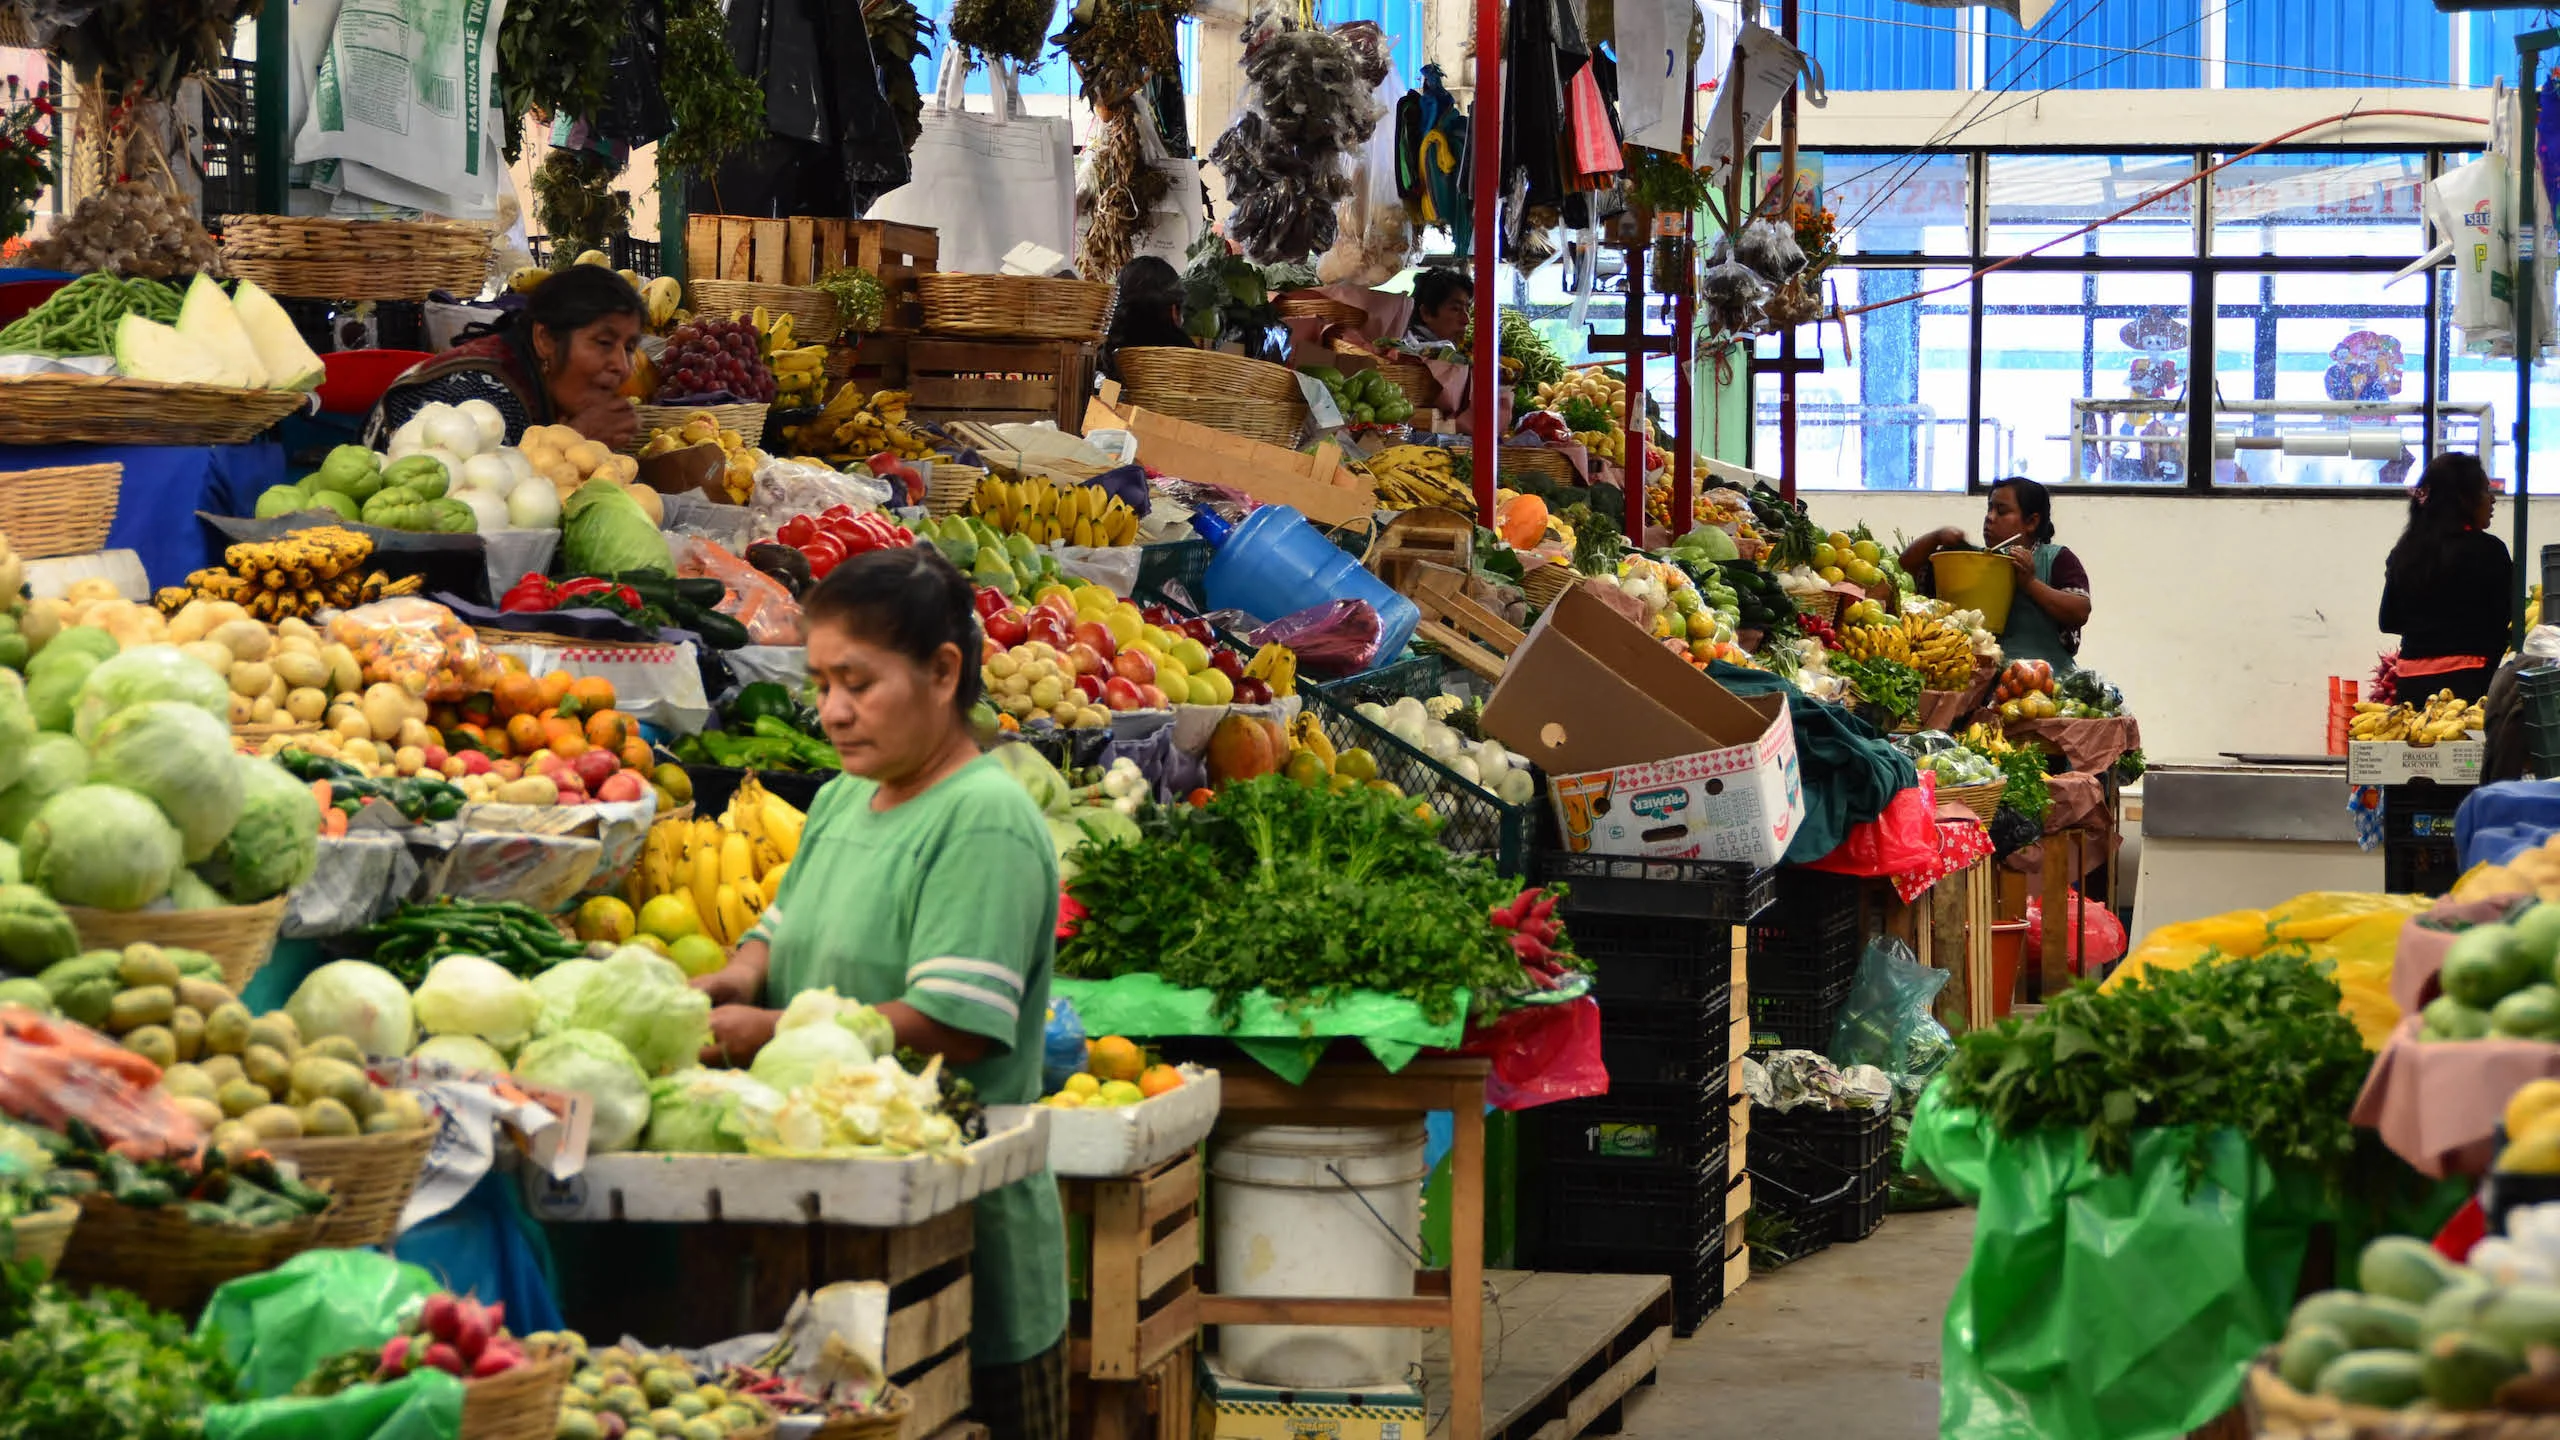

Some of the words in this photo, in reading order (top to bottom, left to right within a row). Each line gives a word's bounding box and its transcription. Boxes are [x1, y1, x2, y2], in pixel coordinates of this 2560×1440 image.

[466, 28, 479, 54] DE
[468, 59, 478, 132] HARINA
[1634, 793, 1687, 811] PREMIER
